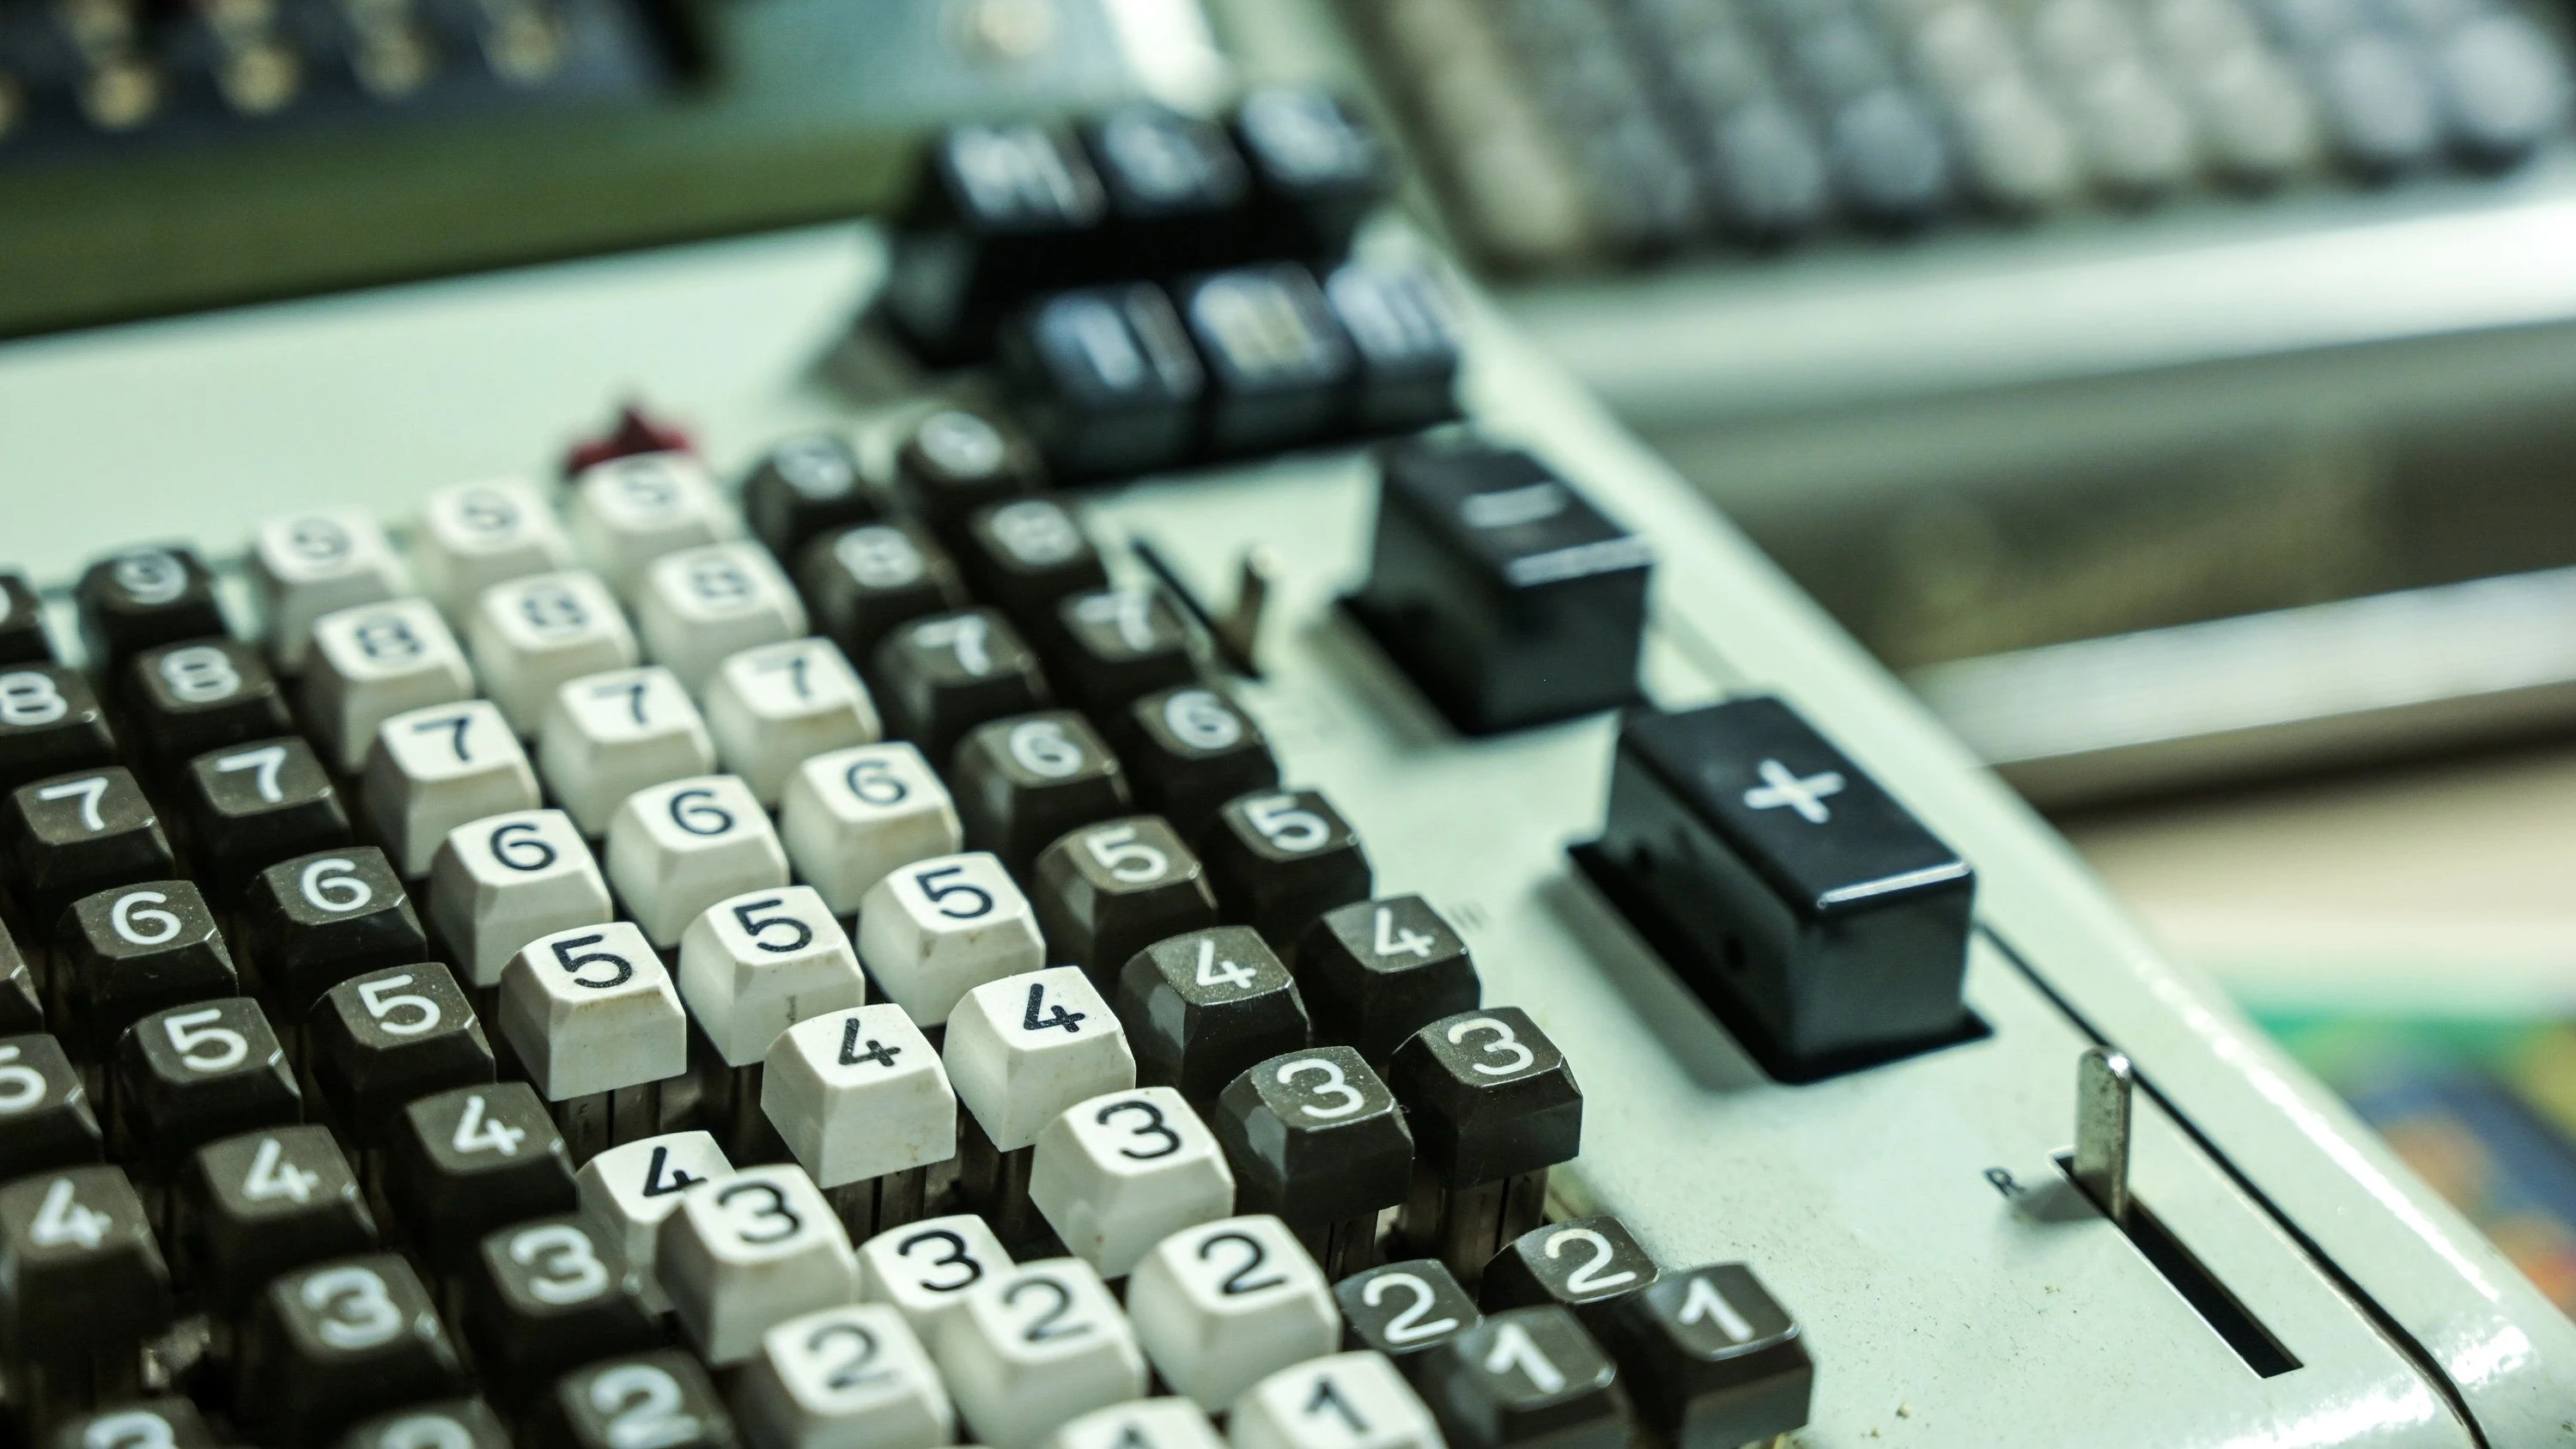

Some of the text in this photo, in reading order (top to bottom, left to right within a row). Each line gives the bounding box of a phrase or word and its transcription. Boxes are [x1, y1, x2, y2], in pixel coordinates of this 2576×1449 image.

[117, 547, 187, 605] 9
[911, 614, 991, 676] 7
[1077, 591, 1156, 651] 7
[0, 671, 68, 726] 8
[161, 647, 242, 703] 8
[589, 682, 649, 727] 7
[411, 715, 472, 764] 7
[1009, 720, 1084, 777] 6
[1164, 690, 1242, 750] 6
[39, 776, 109, 831] 7
[216, 746, 288, 804] 7
[846, 759, 909, 807] 6
[669, 788, 737, 836] 6
[1245, 794, 1330, 852] 5
[489, 822, 556, 872] 6
[1084, 823, 1170, 884] 5
[301, 858, 373, 912] 6
[914, 866, 993, 919] 5
[111, 891, 182, 945] 6
[731, 898, 813, 953] 5
[1372, 906, 1437, 959] 4
[550, 934, 633, 989] 5
[1194, 938, 1258, 990] 4
[357, 974, 441, 1034] 5
[1023, 982, 1086, 1033] 4
[163, 1008, 248, 1070] 5
[837, 1017, 902, 1068] 4
[1448, 1016, 1535, 1076] 3
[1276, 1057, 1365, 1120] 3
[452, 1094, 526, 1156] 4
[1096, 1099, 1182, 1160] 3
[240, 1138, 320, 1203] 4
[642, 1146, 708, 1198] 4
[1983, 1165, 2028, 1197] R
[29, 1177, 112, 1249] 4
[716, 1179, 802, 1246] 3
[509, 1223, 611, 1305] 3
[897, 1228, 984, 1293] 3
[1199, 1229, 1289, 1296] 2
[1544, 1227, 1637, 1296] 2
[301, 1266, 403, 1350] 3
[1001, 1275, 1096, 1342] 2
[1362, 1271, 1460, 1345] 2
[1677, 1276, 1756, 1345] 1
[805, 1321, 897, 1391] 2
[1483, 1320, 1569, 1397] 1
[589, 1363, 704, 1449] 2
[1303, 1377, 1369, 1435] 1
